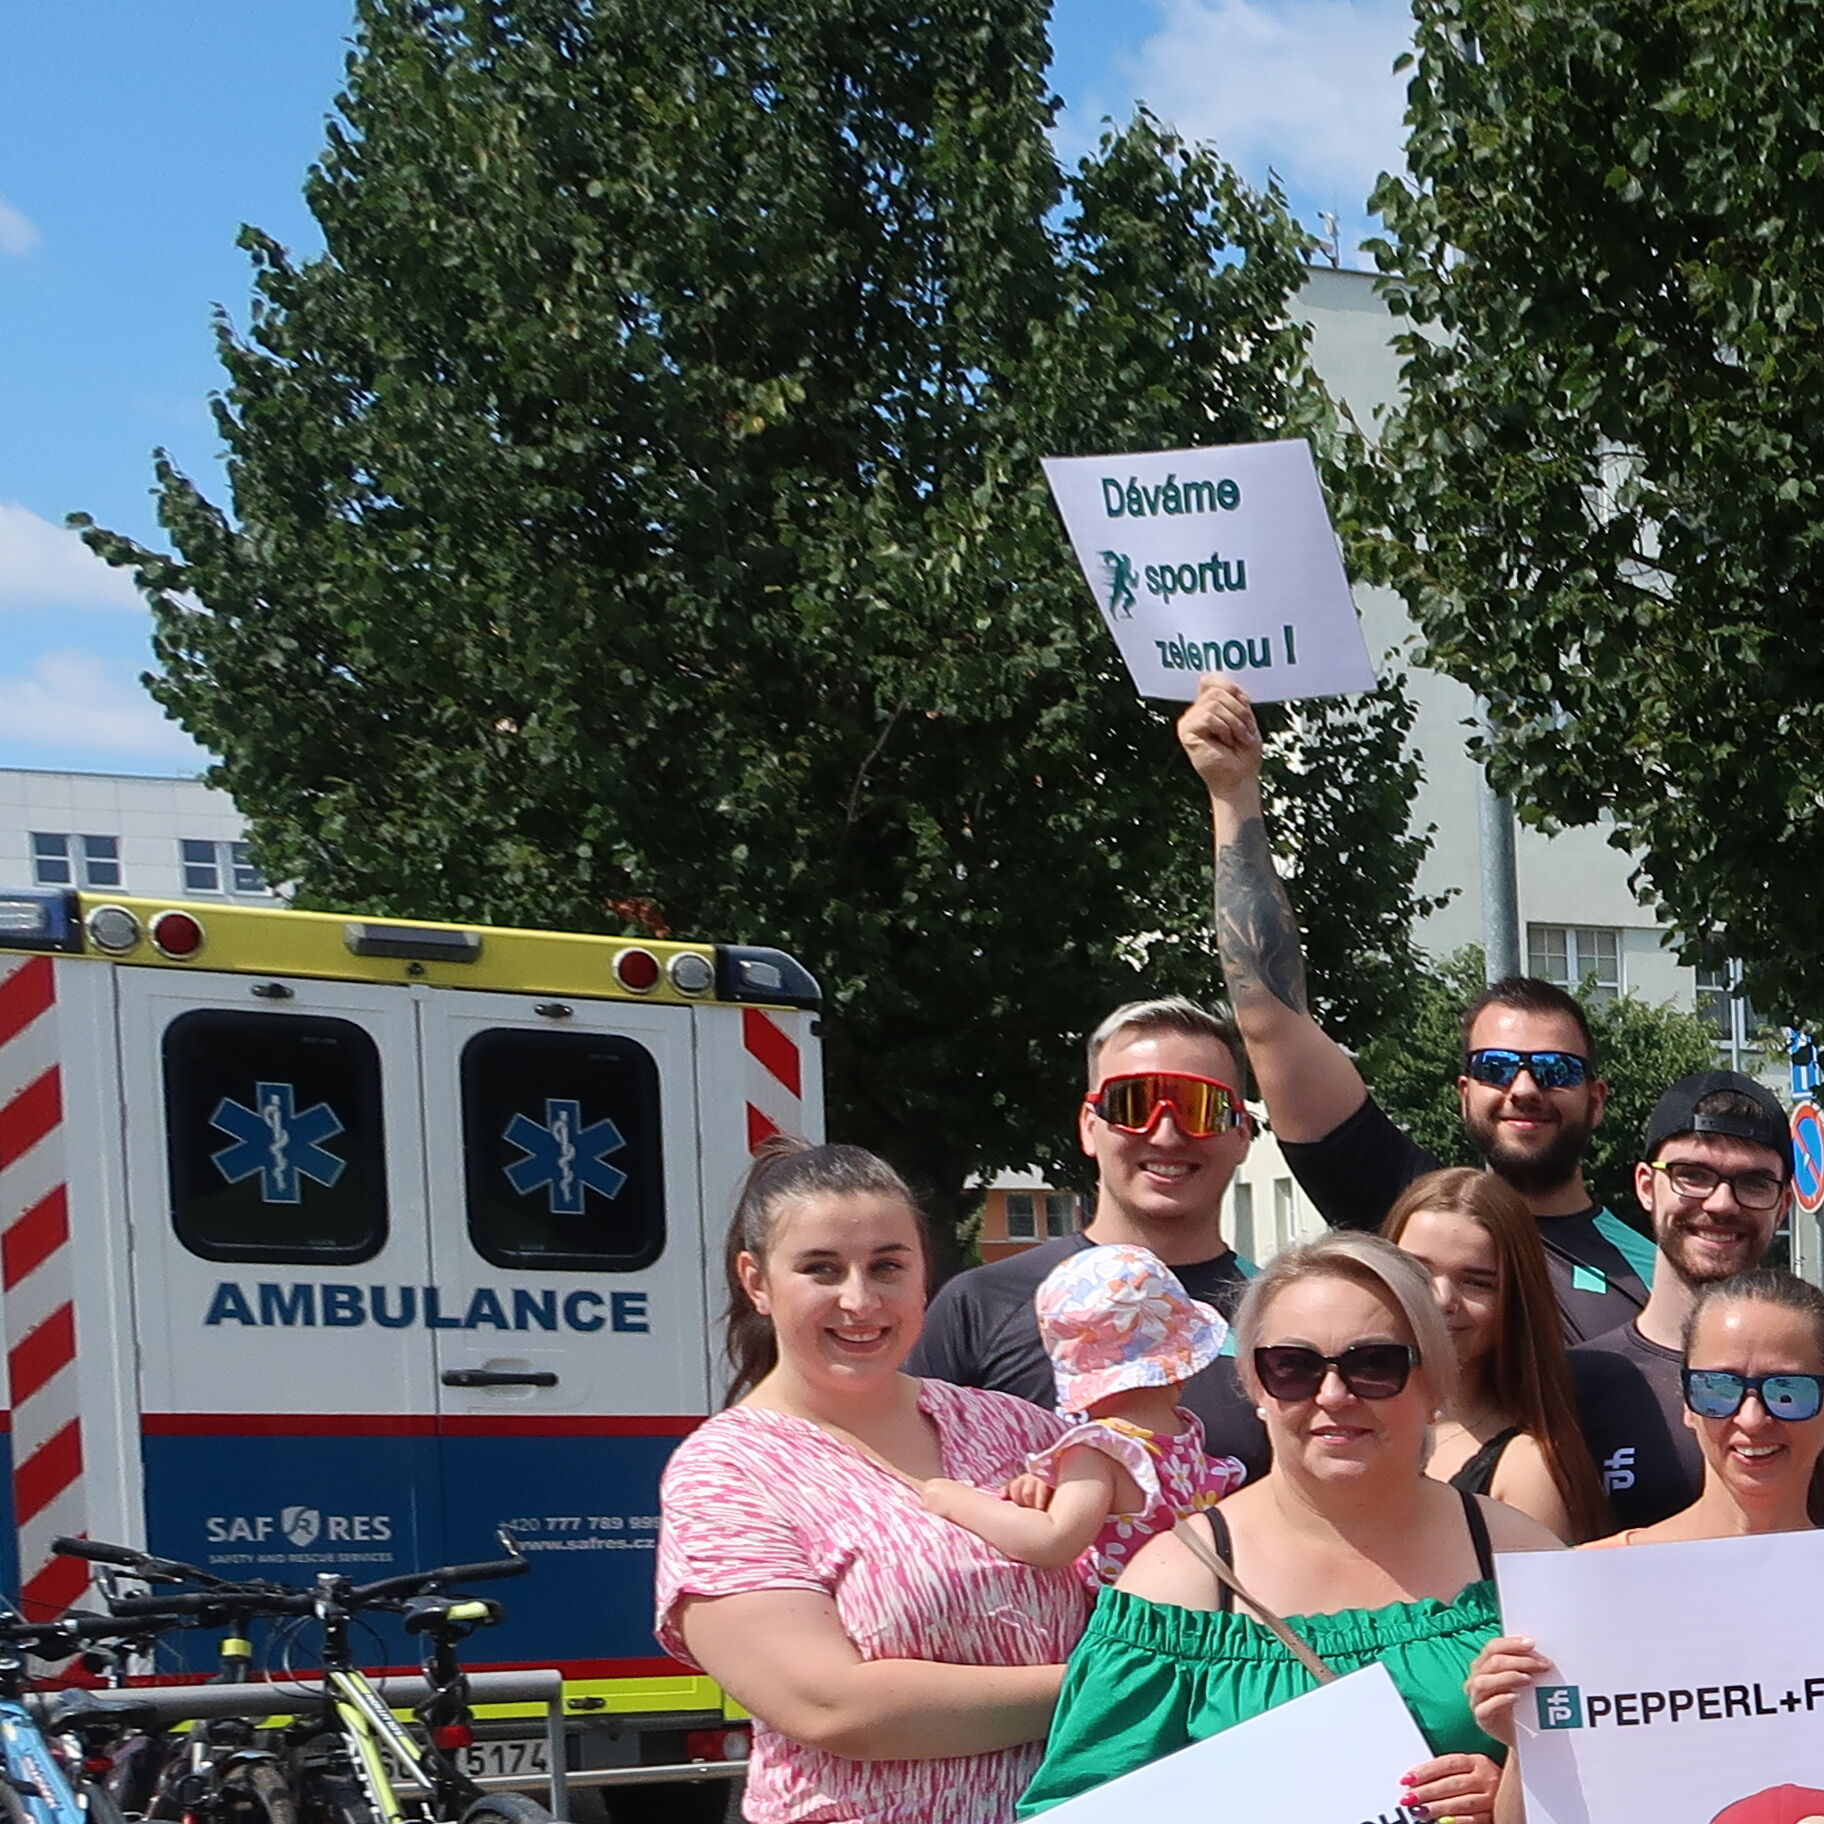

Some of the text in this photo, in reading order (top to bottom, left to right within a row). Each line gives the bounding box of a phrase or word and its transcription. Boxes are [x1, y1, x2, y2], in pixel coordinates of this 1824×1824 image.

[1102, 473, 1241, 518] Dáváme
[1144, 552, 1247, 604] sportu
[1155, 632, 1273, 671] zelenou
[205, 1282, 650, 1333] AMBULANCE
[206, 1516, 393, 1542] SAF RES
[545, 1516, 582, 1531] 777
[466, 1743, 547, 1775] 5174
